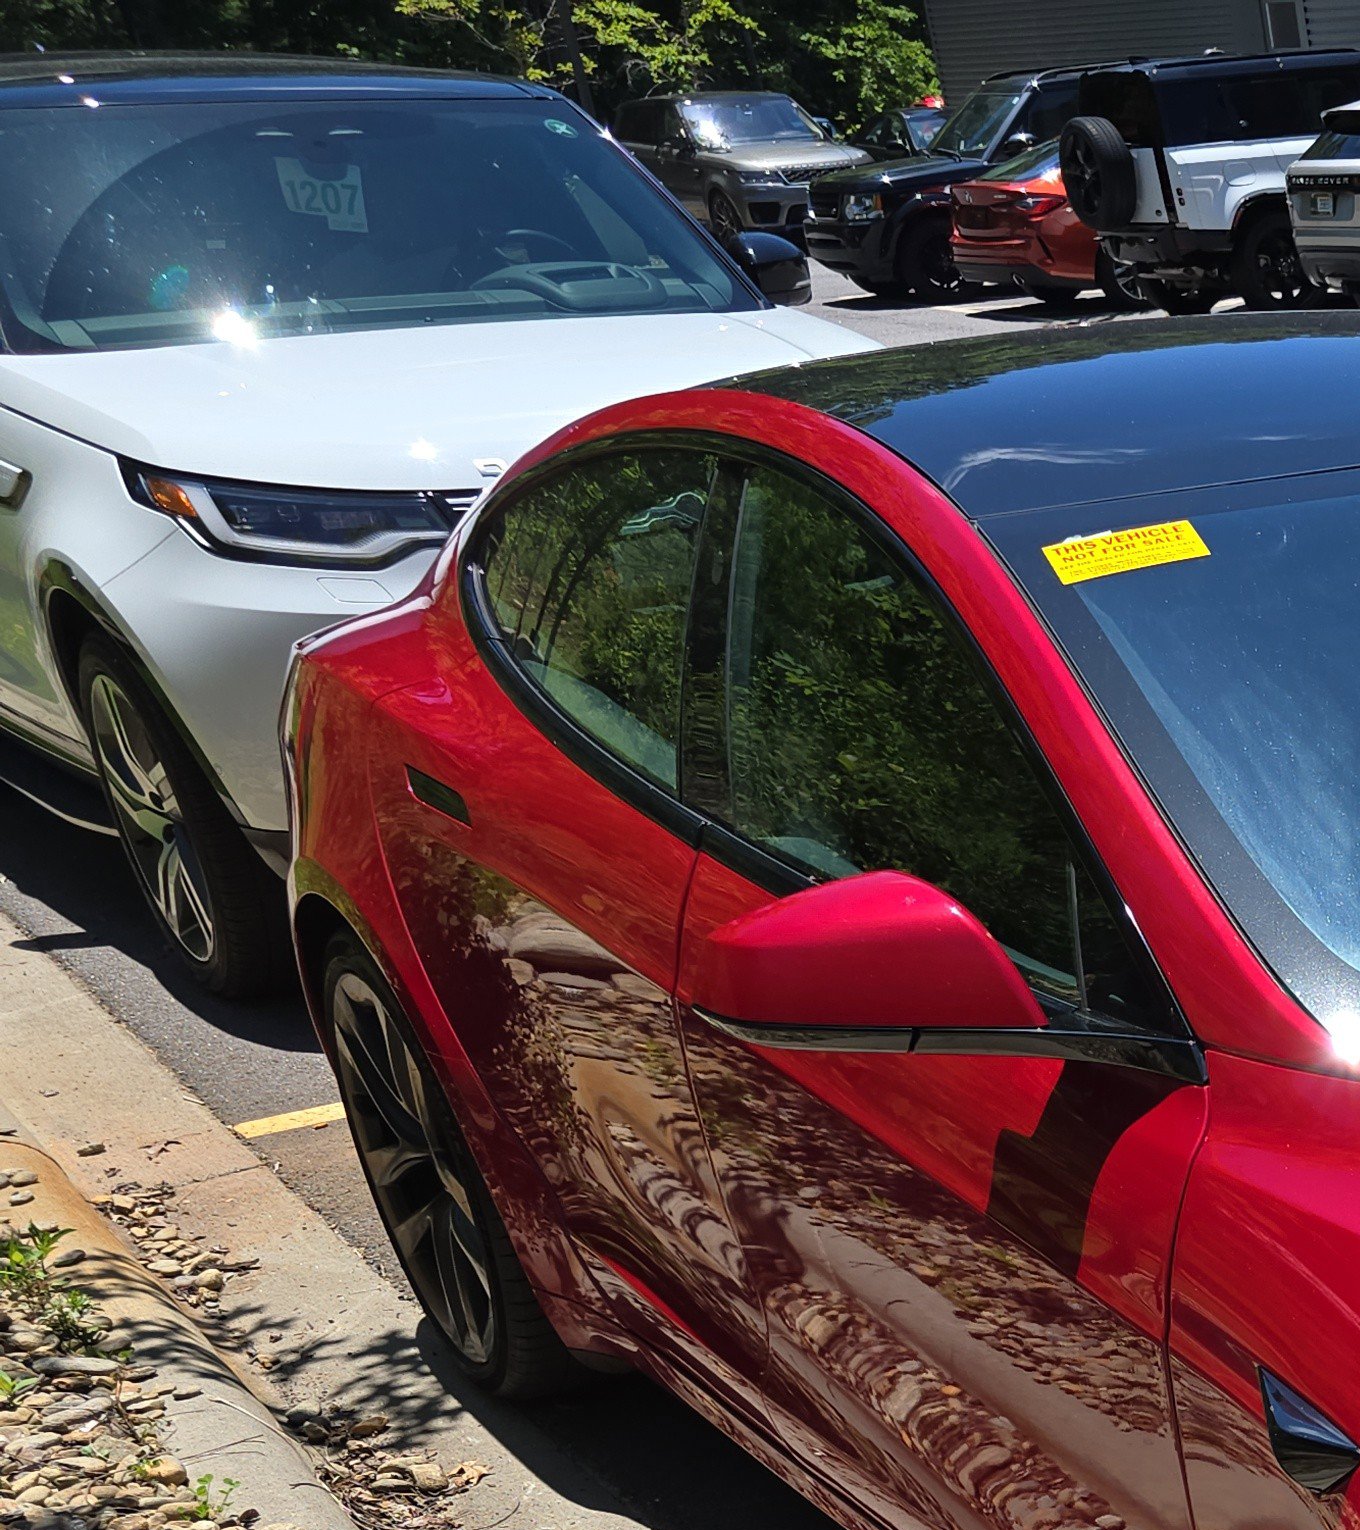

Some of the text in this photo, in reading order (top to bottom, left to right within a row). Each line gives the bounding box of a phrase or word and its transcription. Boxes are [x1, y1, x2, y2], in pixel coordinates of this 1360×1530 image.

[284, 179, 359, 216] 1207
[1052, 541, 1097, 557] THIS
[1101, 525, 1185, 546] VEHICLE
[1062, 551, 1097, 563] NOT
[1102, 543, 1137, 555] FOR
[1143, 534, 1185, 547] SALE
